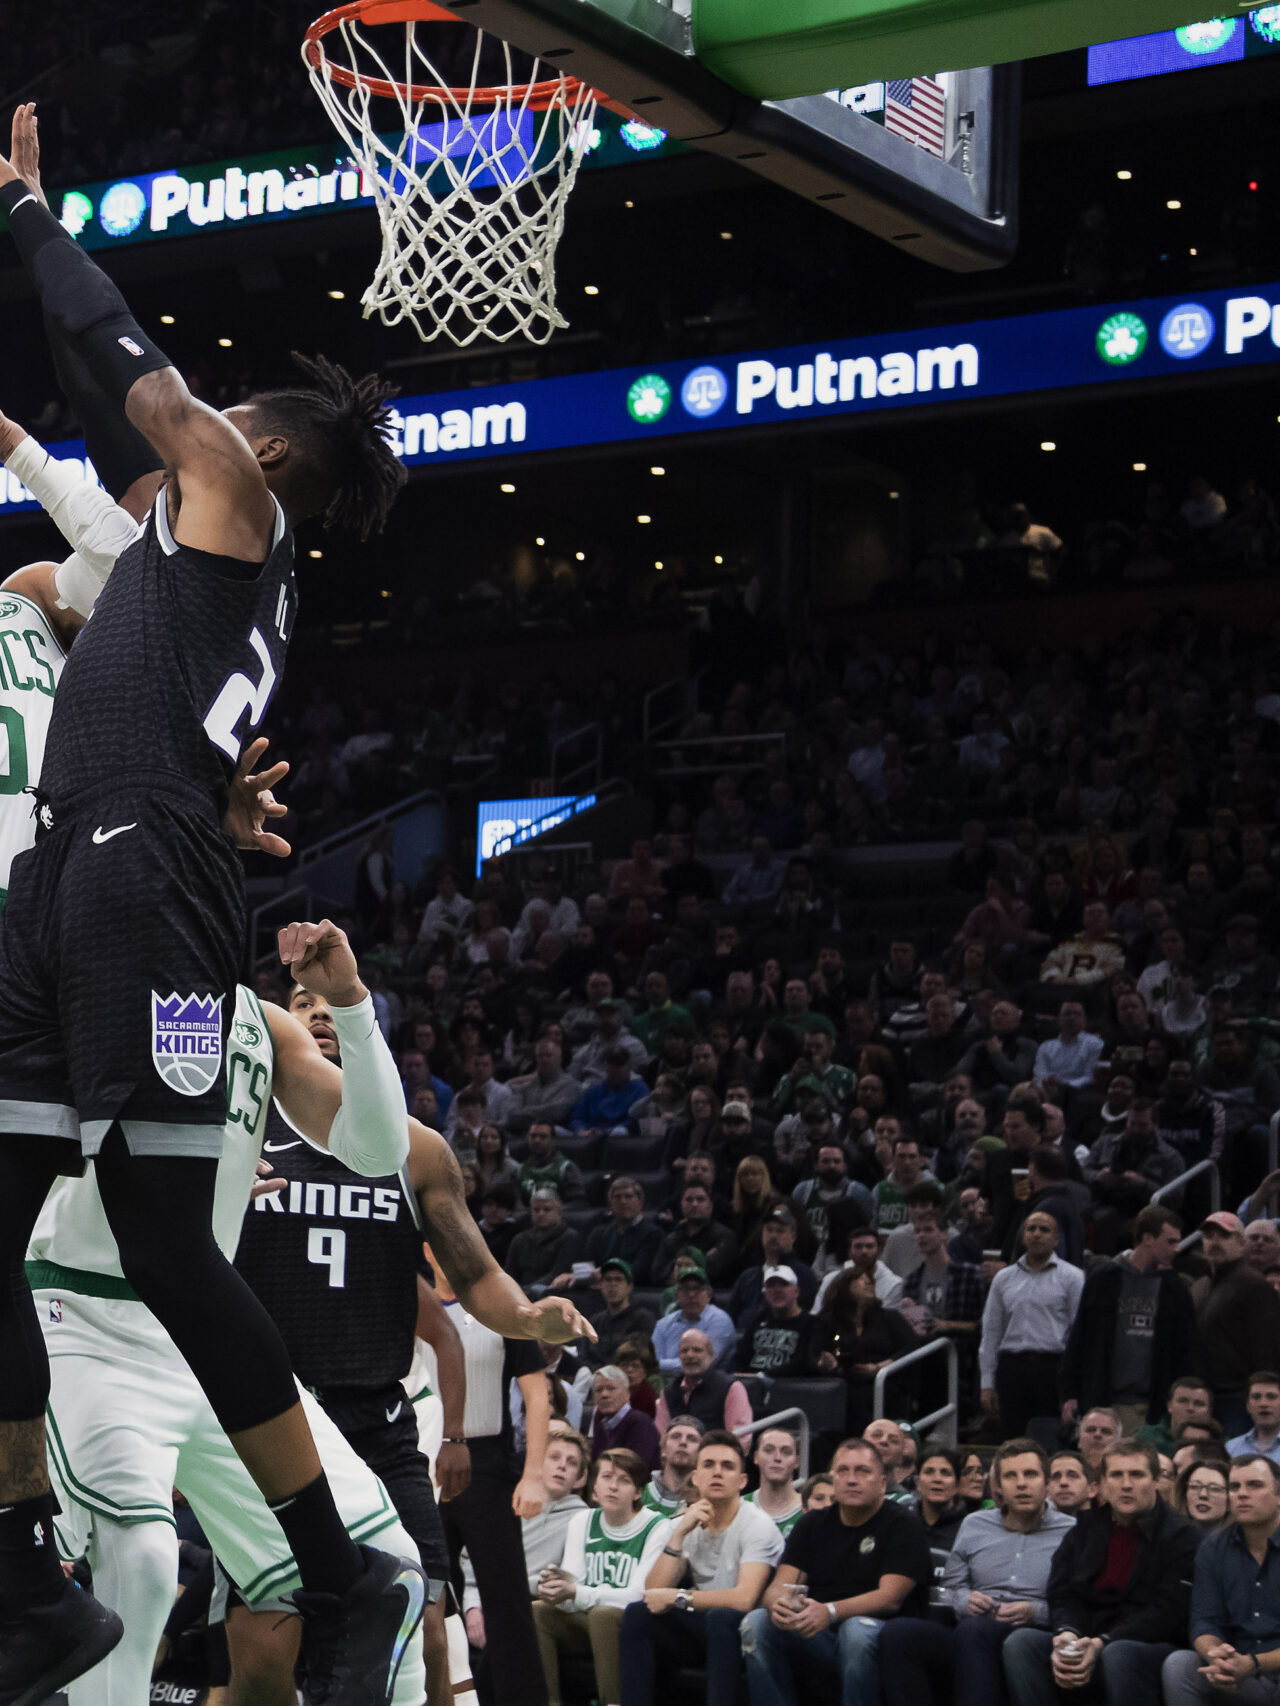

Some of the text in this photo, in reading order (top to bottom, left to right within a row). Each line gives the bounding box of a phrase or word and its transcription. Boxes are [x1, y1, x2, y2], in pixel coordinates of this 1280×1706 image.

[736, 343, 979, 414] Putnam
[157, 1020, 219, 1032] SACRAMENTO
[154, 1033, 220, 1055] KINGS
[254, 1179, 401, 1222] KINGS
[307, 1227, 347, 1289] 9
[151, 1681, 199, 1704] Blue
